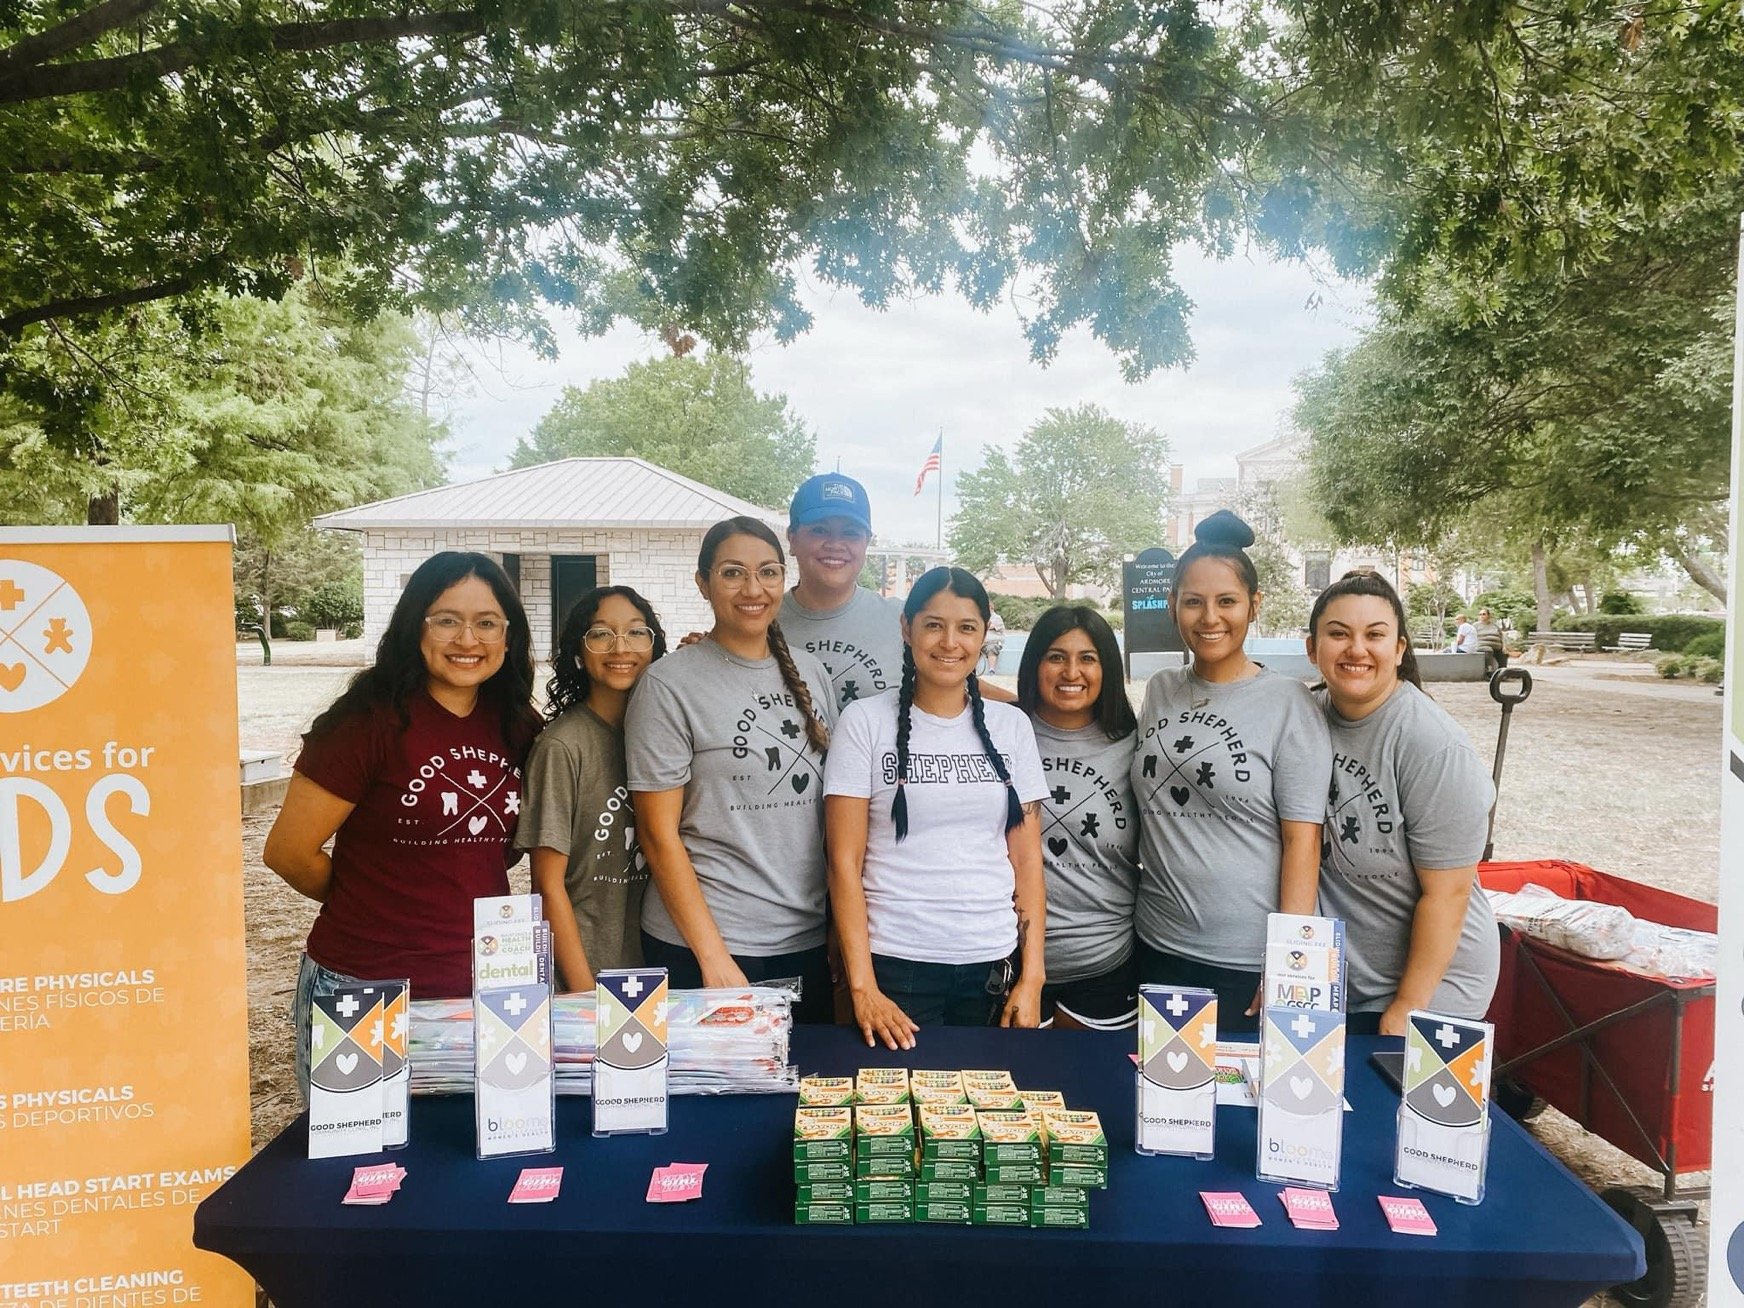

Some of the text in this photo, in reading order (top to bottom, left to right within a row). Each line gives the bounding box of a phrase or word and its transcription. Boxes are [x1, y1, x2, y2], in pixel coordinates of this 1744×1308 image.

[806, 640, 887, 690] SHEPHERD
[733, 708, 757, 759] GOOD
[1179, 711, 1251, 782] SHEPHERD
[102, 741, 155, 769] for
[401, 755, 446, 807] GOOD
[1042, 757, 1127, 830] SHEPHERD
[594, 786, 628, 841] GOOD
[730, 799, 779, 811] BUILDING
[0, 773, 151, 902] DS
[34, 969, 156, 992] PHYSICALS
[479, 959, 534, 980] dental
[46, 989, 129, 1010] FÍSICOS
[136, 987, 165, 1004] DE
[13, 1085, 134, 1109] PHYSICALS
[624, 1096, 665, 1105] SHEPHERD
[13, 1102, 155, 1128] DEPORTIVOS
[311, 1118, 382, 1132] GOOD SHEPHERD
[1144, 1116, 1167, 1124] GOOD
[1168, 1118, 1212, 1128] SHEPHERD
[1403, 1146, 1479, 1171] GOOD SHEPHERD
[18, 1179, 80, 1200] HEAD
[85, 1173, 154, 1194] START
[160, 1165, 237, 1187] EXAMS
[53, 1191, 165, 1216] DENTALES
[172, 1188, 200, 1205] DE
[0, 1219, 61, 1239] START
[1, 1269, 183, 1299] TEETH CLEANING
[75, 1290, 167, 1308] DIENTES
[173, 1286, 201, 1303] DE
